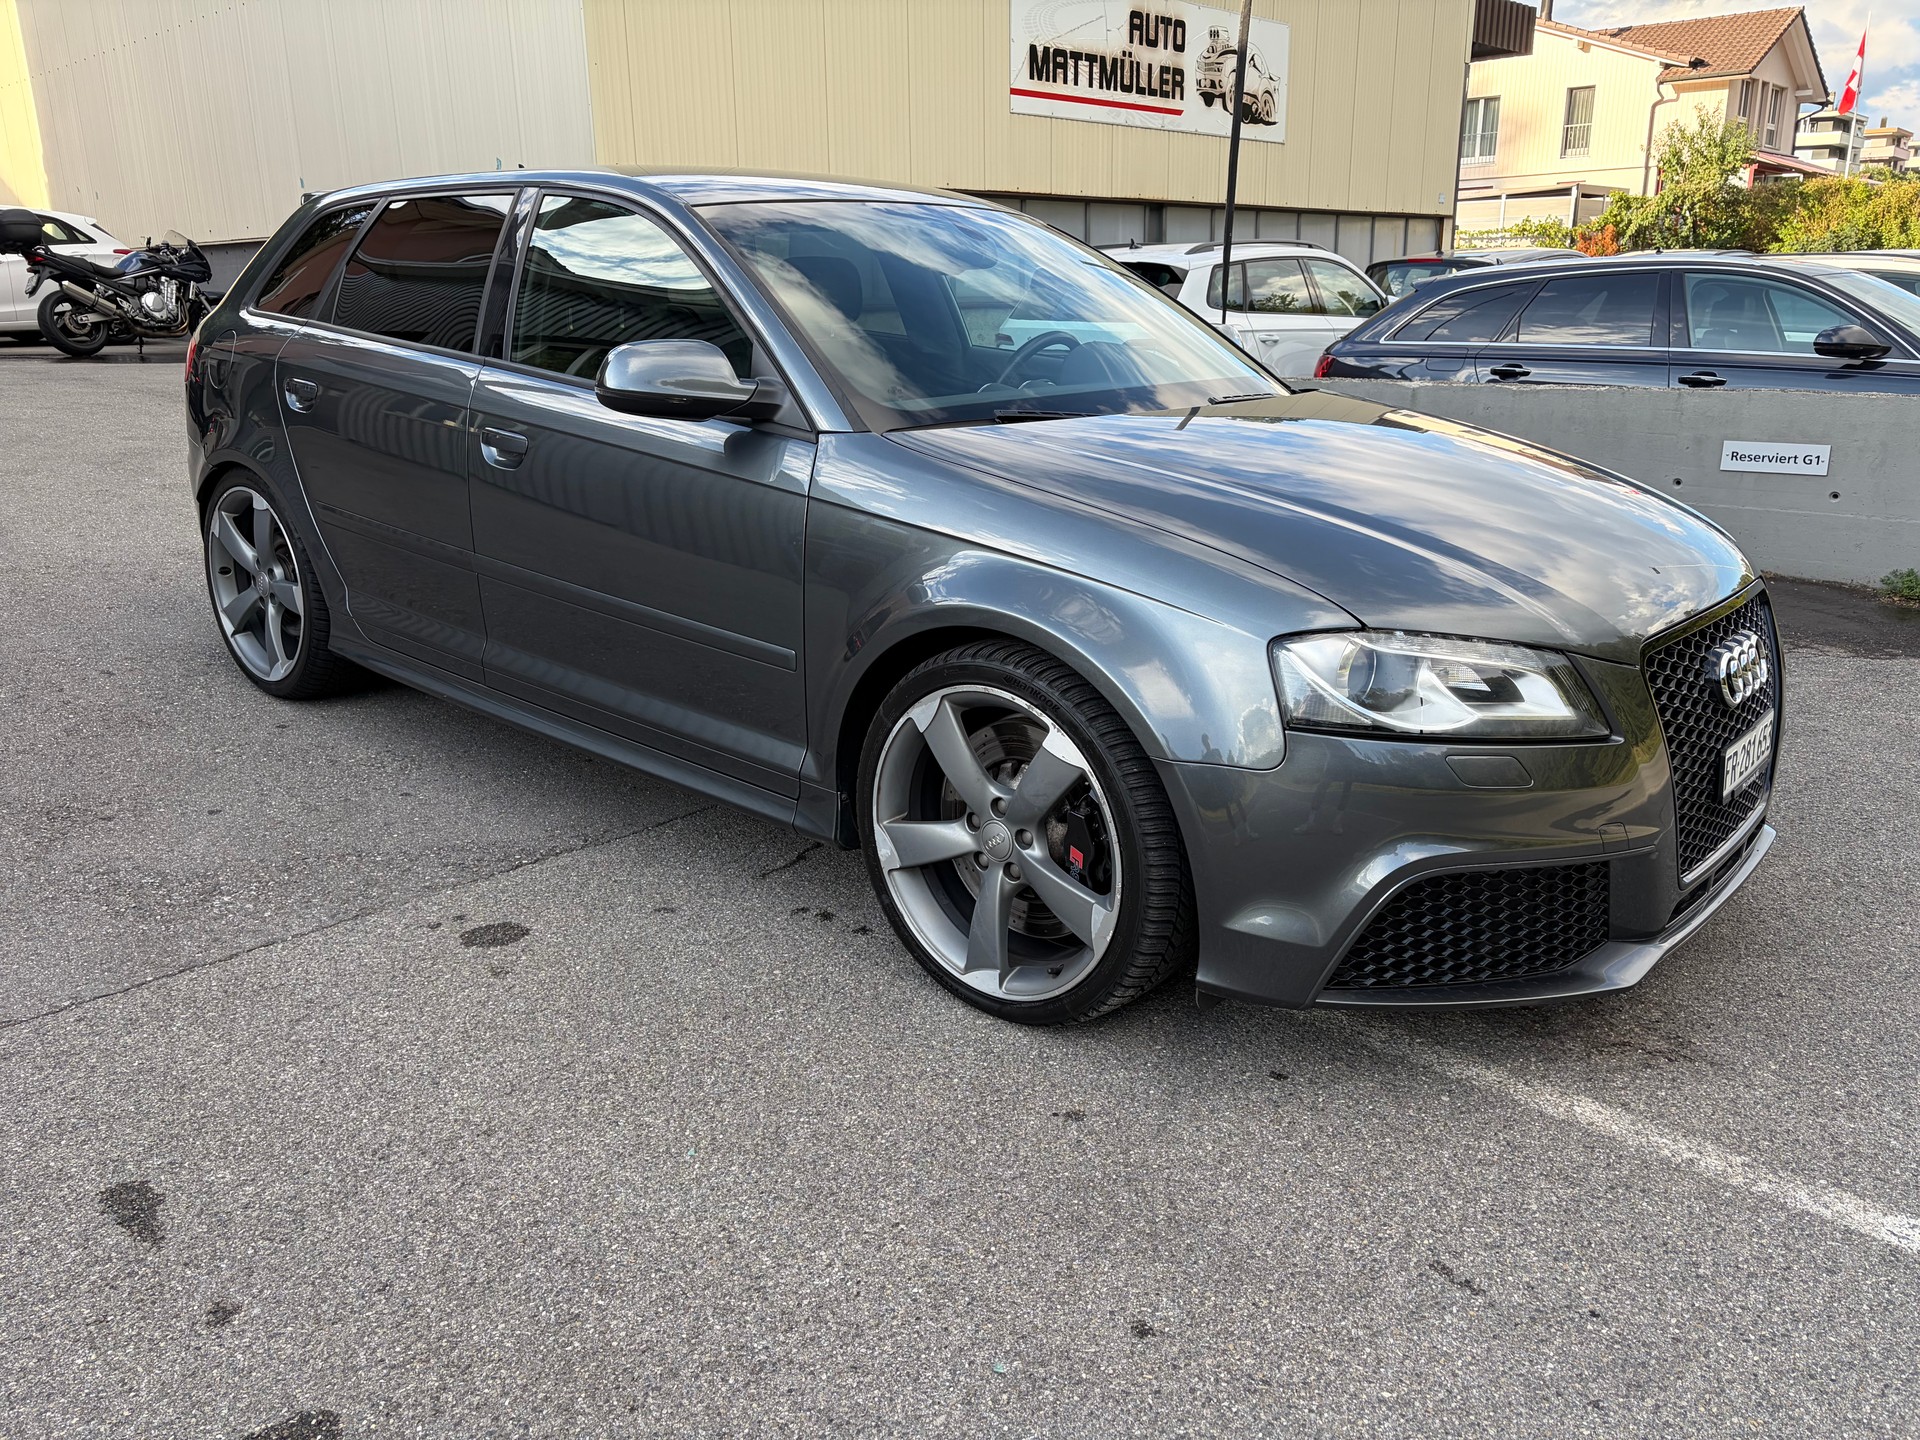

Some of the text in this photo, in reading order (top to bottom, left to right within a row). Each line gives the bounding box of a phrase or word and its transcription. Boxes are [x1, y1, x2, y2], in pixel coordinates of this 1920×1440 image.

[1128, 9, 1187, 53] AUTO
[1028, 43, 1186, 101] MATTMÜLLER
[1730, 451, 1821, 466] Reserviert G1
